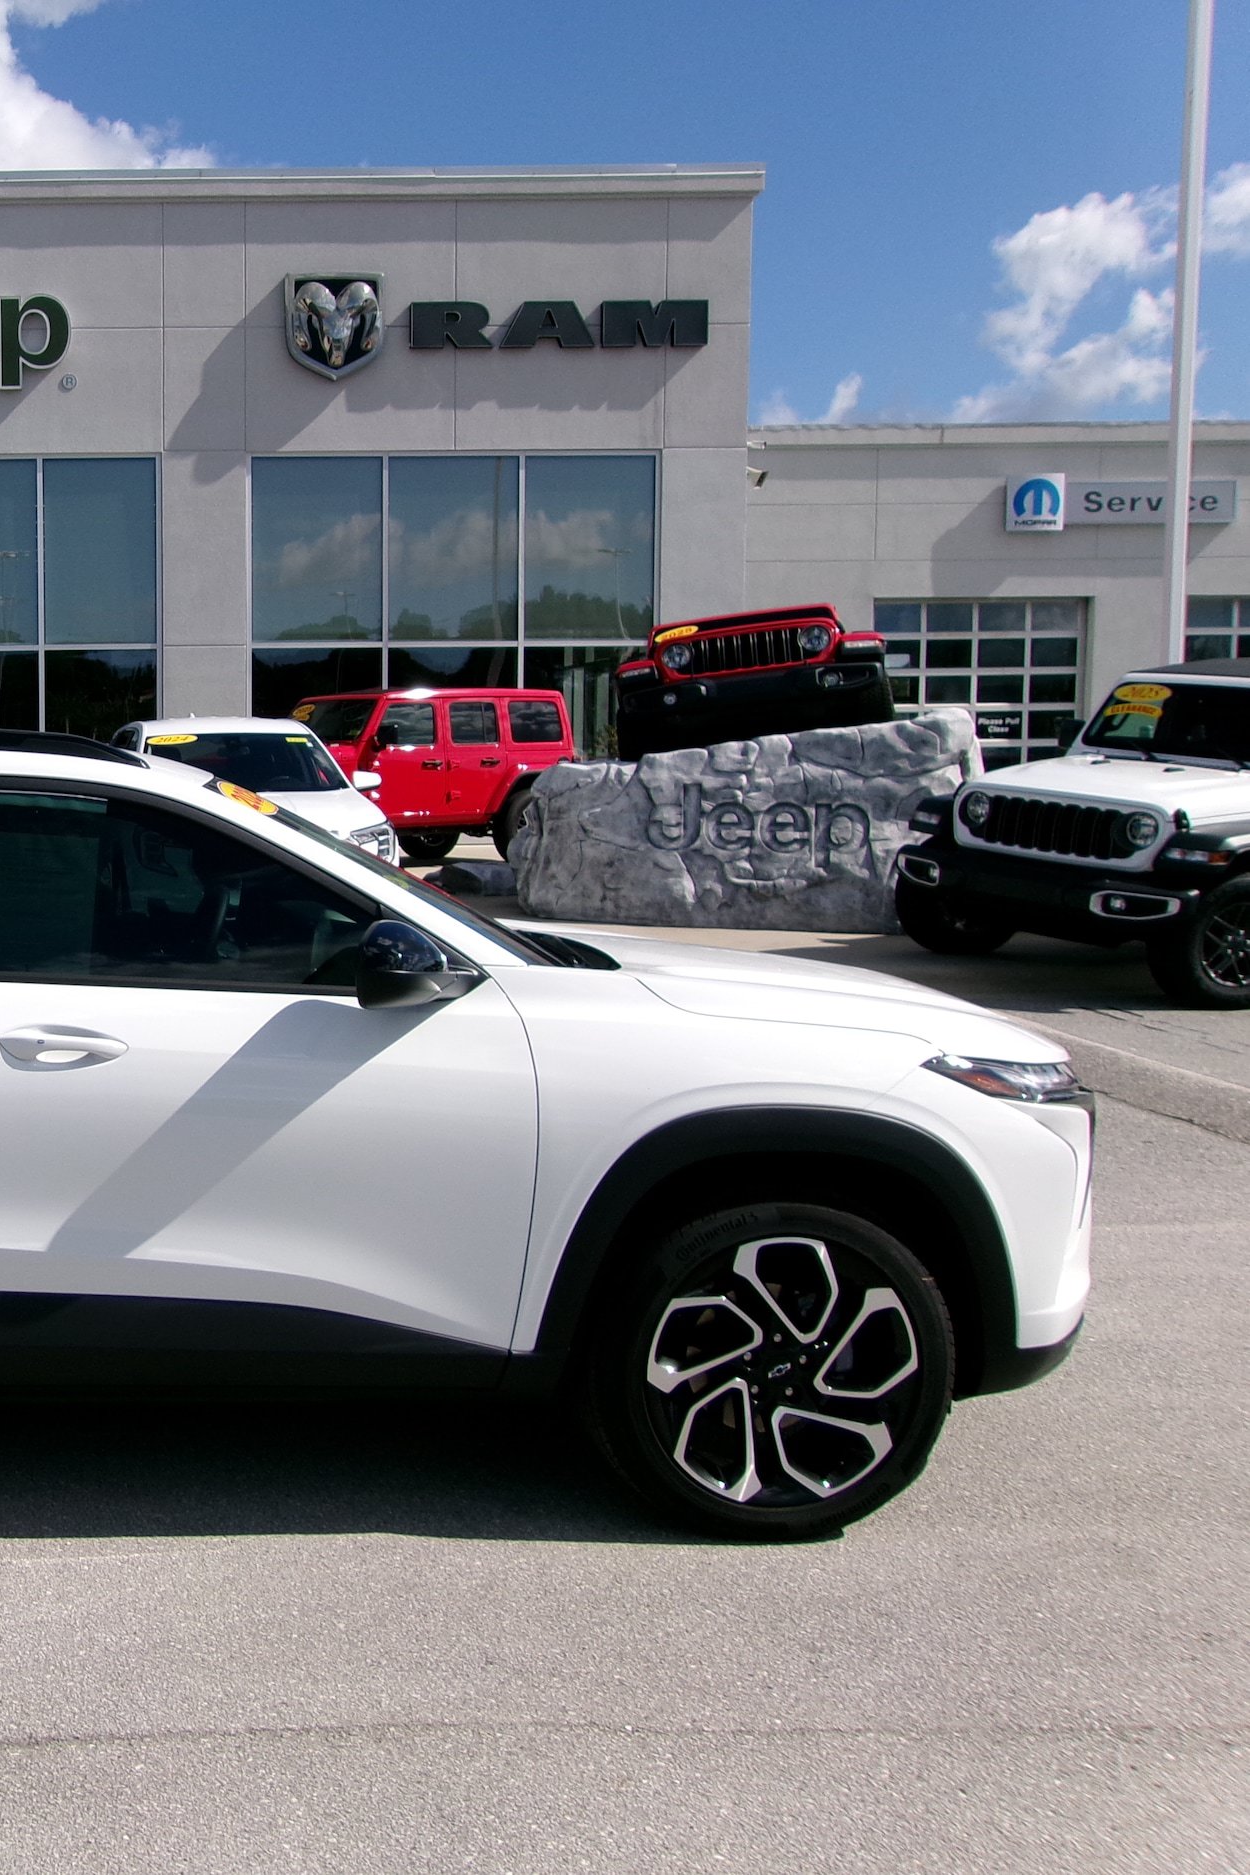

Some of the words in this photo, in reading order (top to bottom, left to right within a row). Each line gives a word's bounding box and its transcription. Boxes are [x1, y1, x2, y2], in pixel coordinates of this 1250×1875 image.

[409, 299, 709, 349] RAM
[1083, 491, 1218, 513] Serve
[1013, 518, 1057, 526] MOPAR
[977, 717, 1003, 726] Please
[648, 783, 870, 869] Jeep
